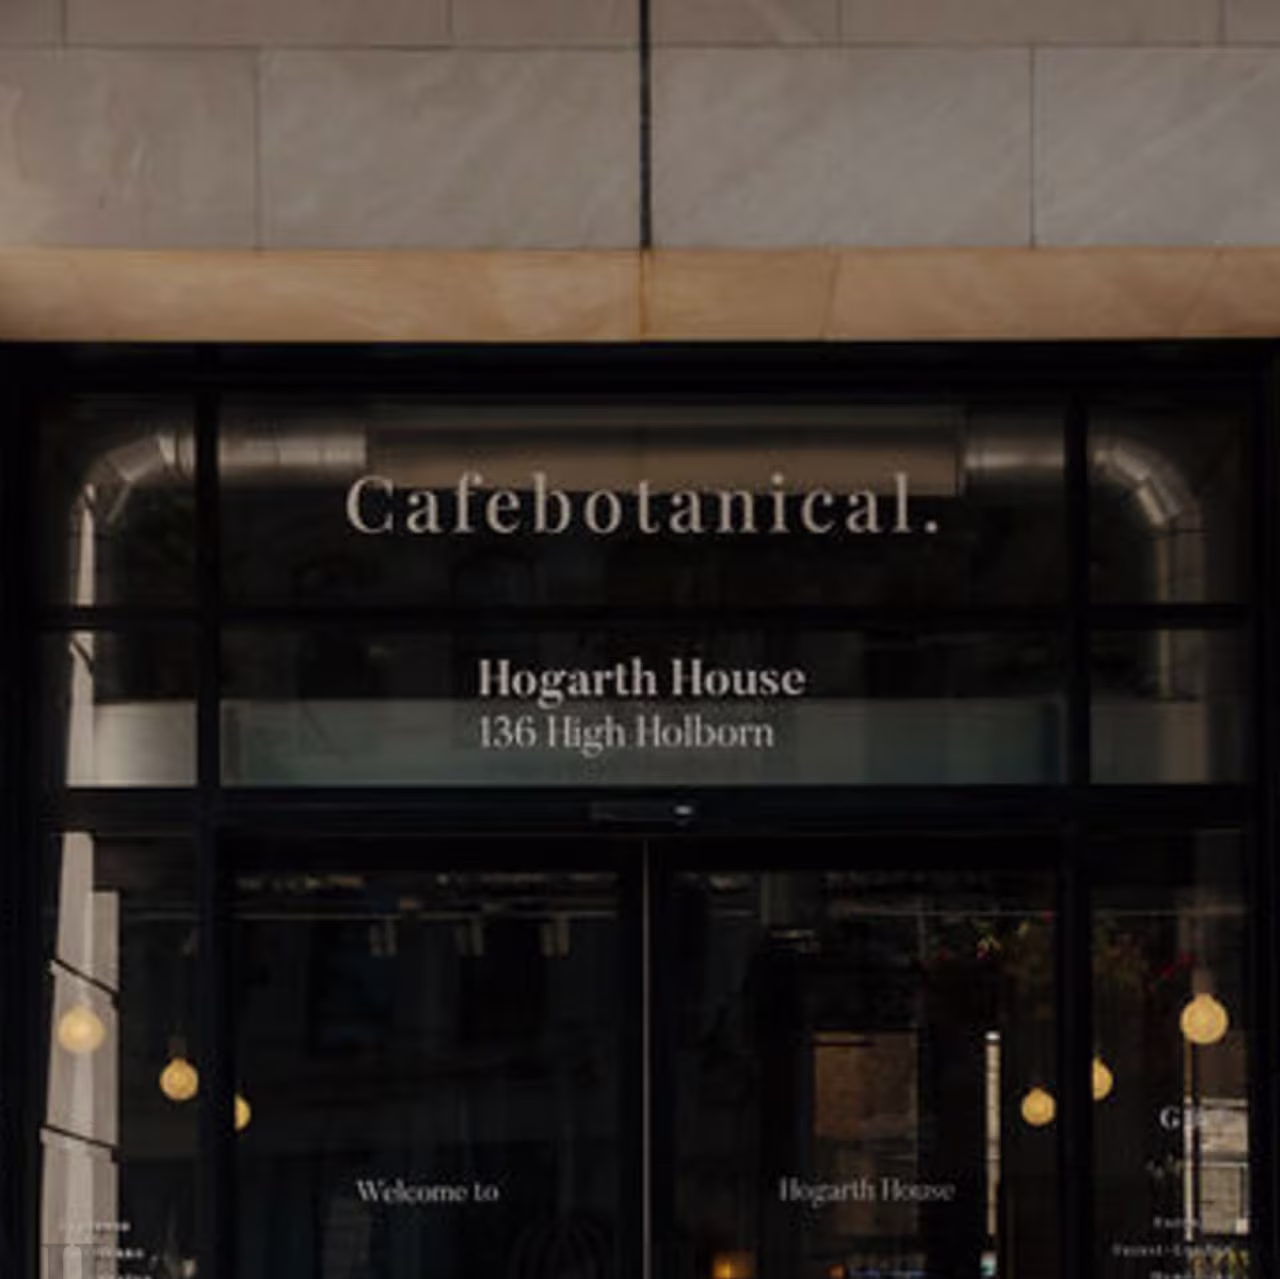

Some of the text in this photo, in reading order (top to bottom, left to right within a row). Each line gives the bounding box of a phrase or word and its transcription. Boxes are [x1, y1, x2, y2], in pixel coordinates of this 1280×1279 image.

[344, 472, 940, 537] Cafebotanical.
[478, 657, 807, 708] Hogarth House
[479, 713, 776, 758] 136 High Holborn
[355, 1177, 500, 1203] Welcome to
[778, 1175, 958, 1209] Hogarth House
